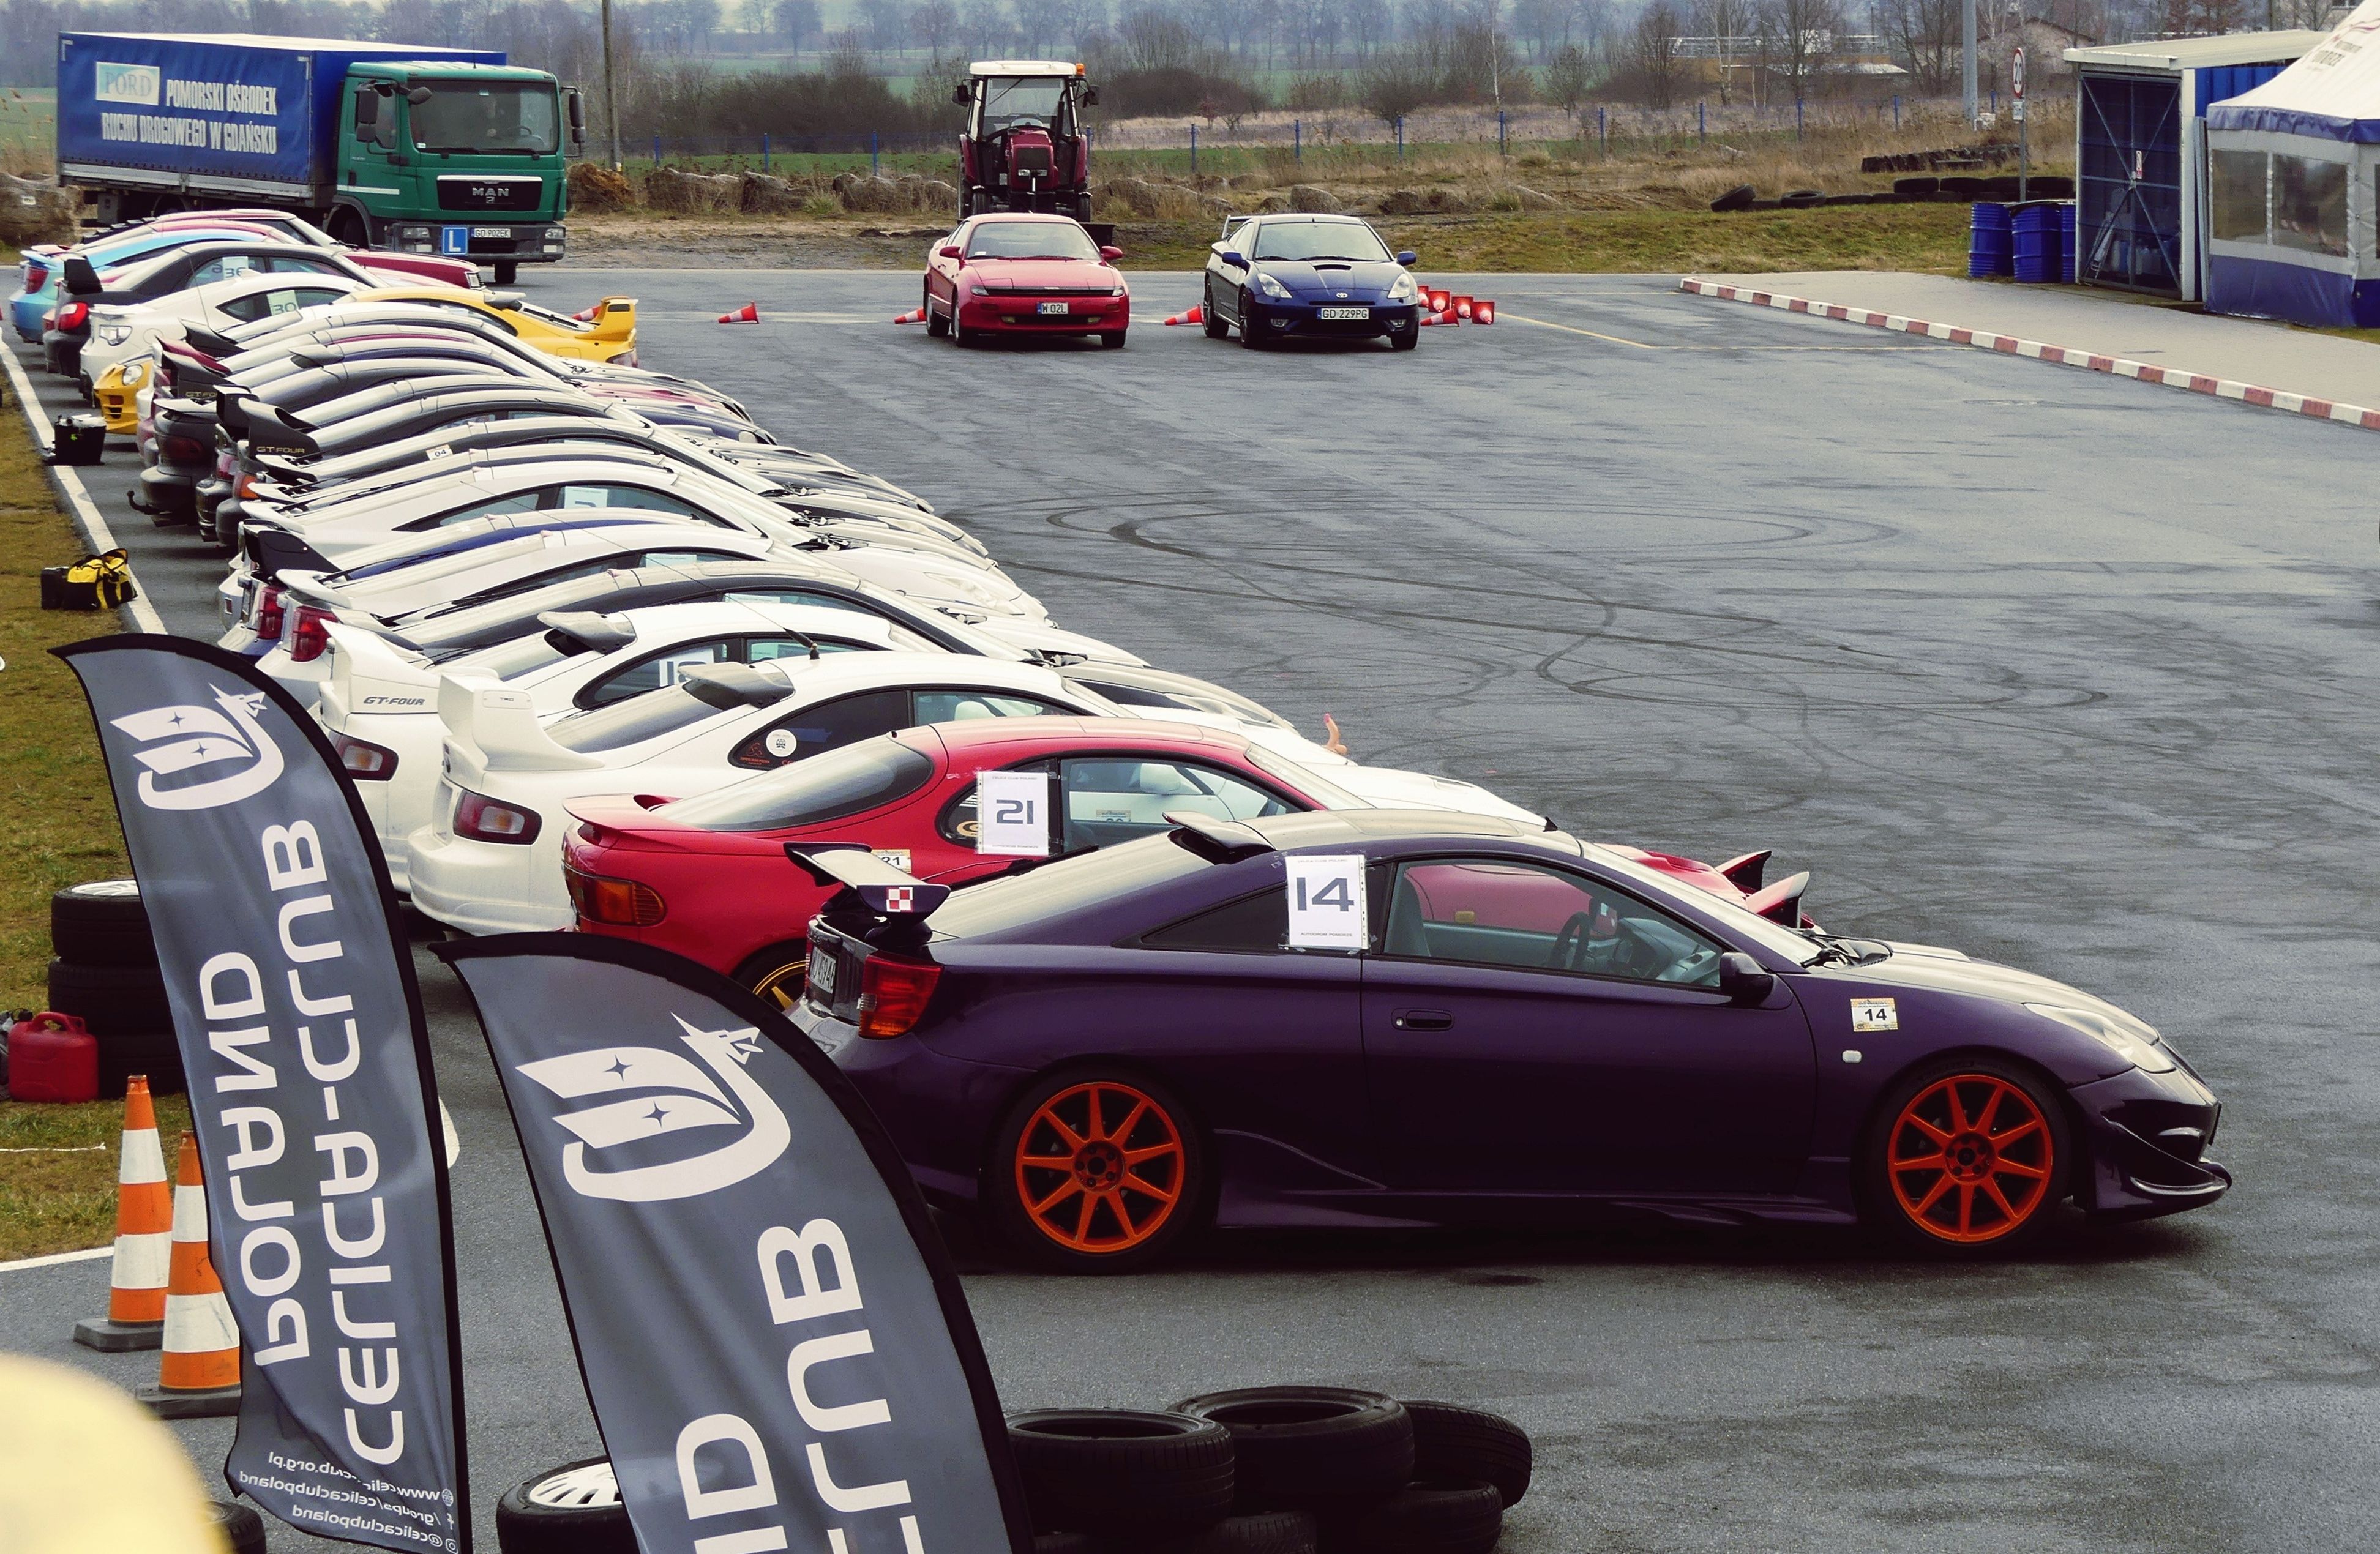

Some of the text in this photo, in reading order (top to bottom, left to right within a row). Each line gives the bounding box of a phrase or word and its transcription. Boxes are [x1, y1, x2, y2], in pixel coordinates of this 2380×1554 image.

[105, 71, 152, 97] PORD
[166, 78, 277, 116] POMORSKI OŚRODEK
[101, 112, 277, 154] RUCHU DROGOWEGO W GDAŃSKU
[472, 187, 509, 196] MAN
[449, 230, 461, 252] L
[1322, 309, 1368, 318] GD 229PG
[435, 449, 447, 457] 04
[996, 799, 1034, 824] 21
[1296, 877, 1355, 912] 14
[1865, 1008, 1887, 1021] 14
